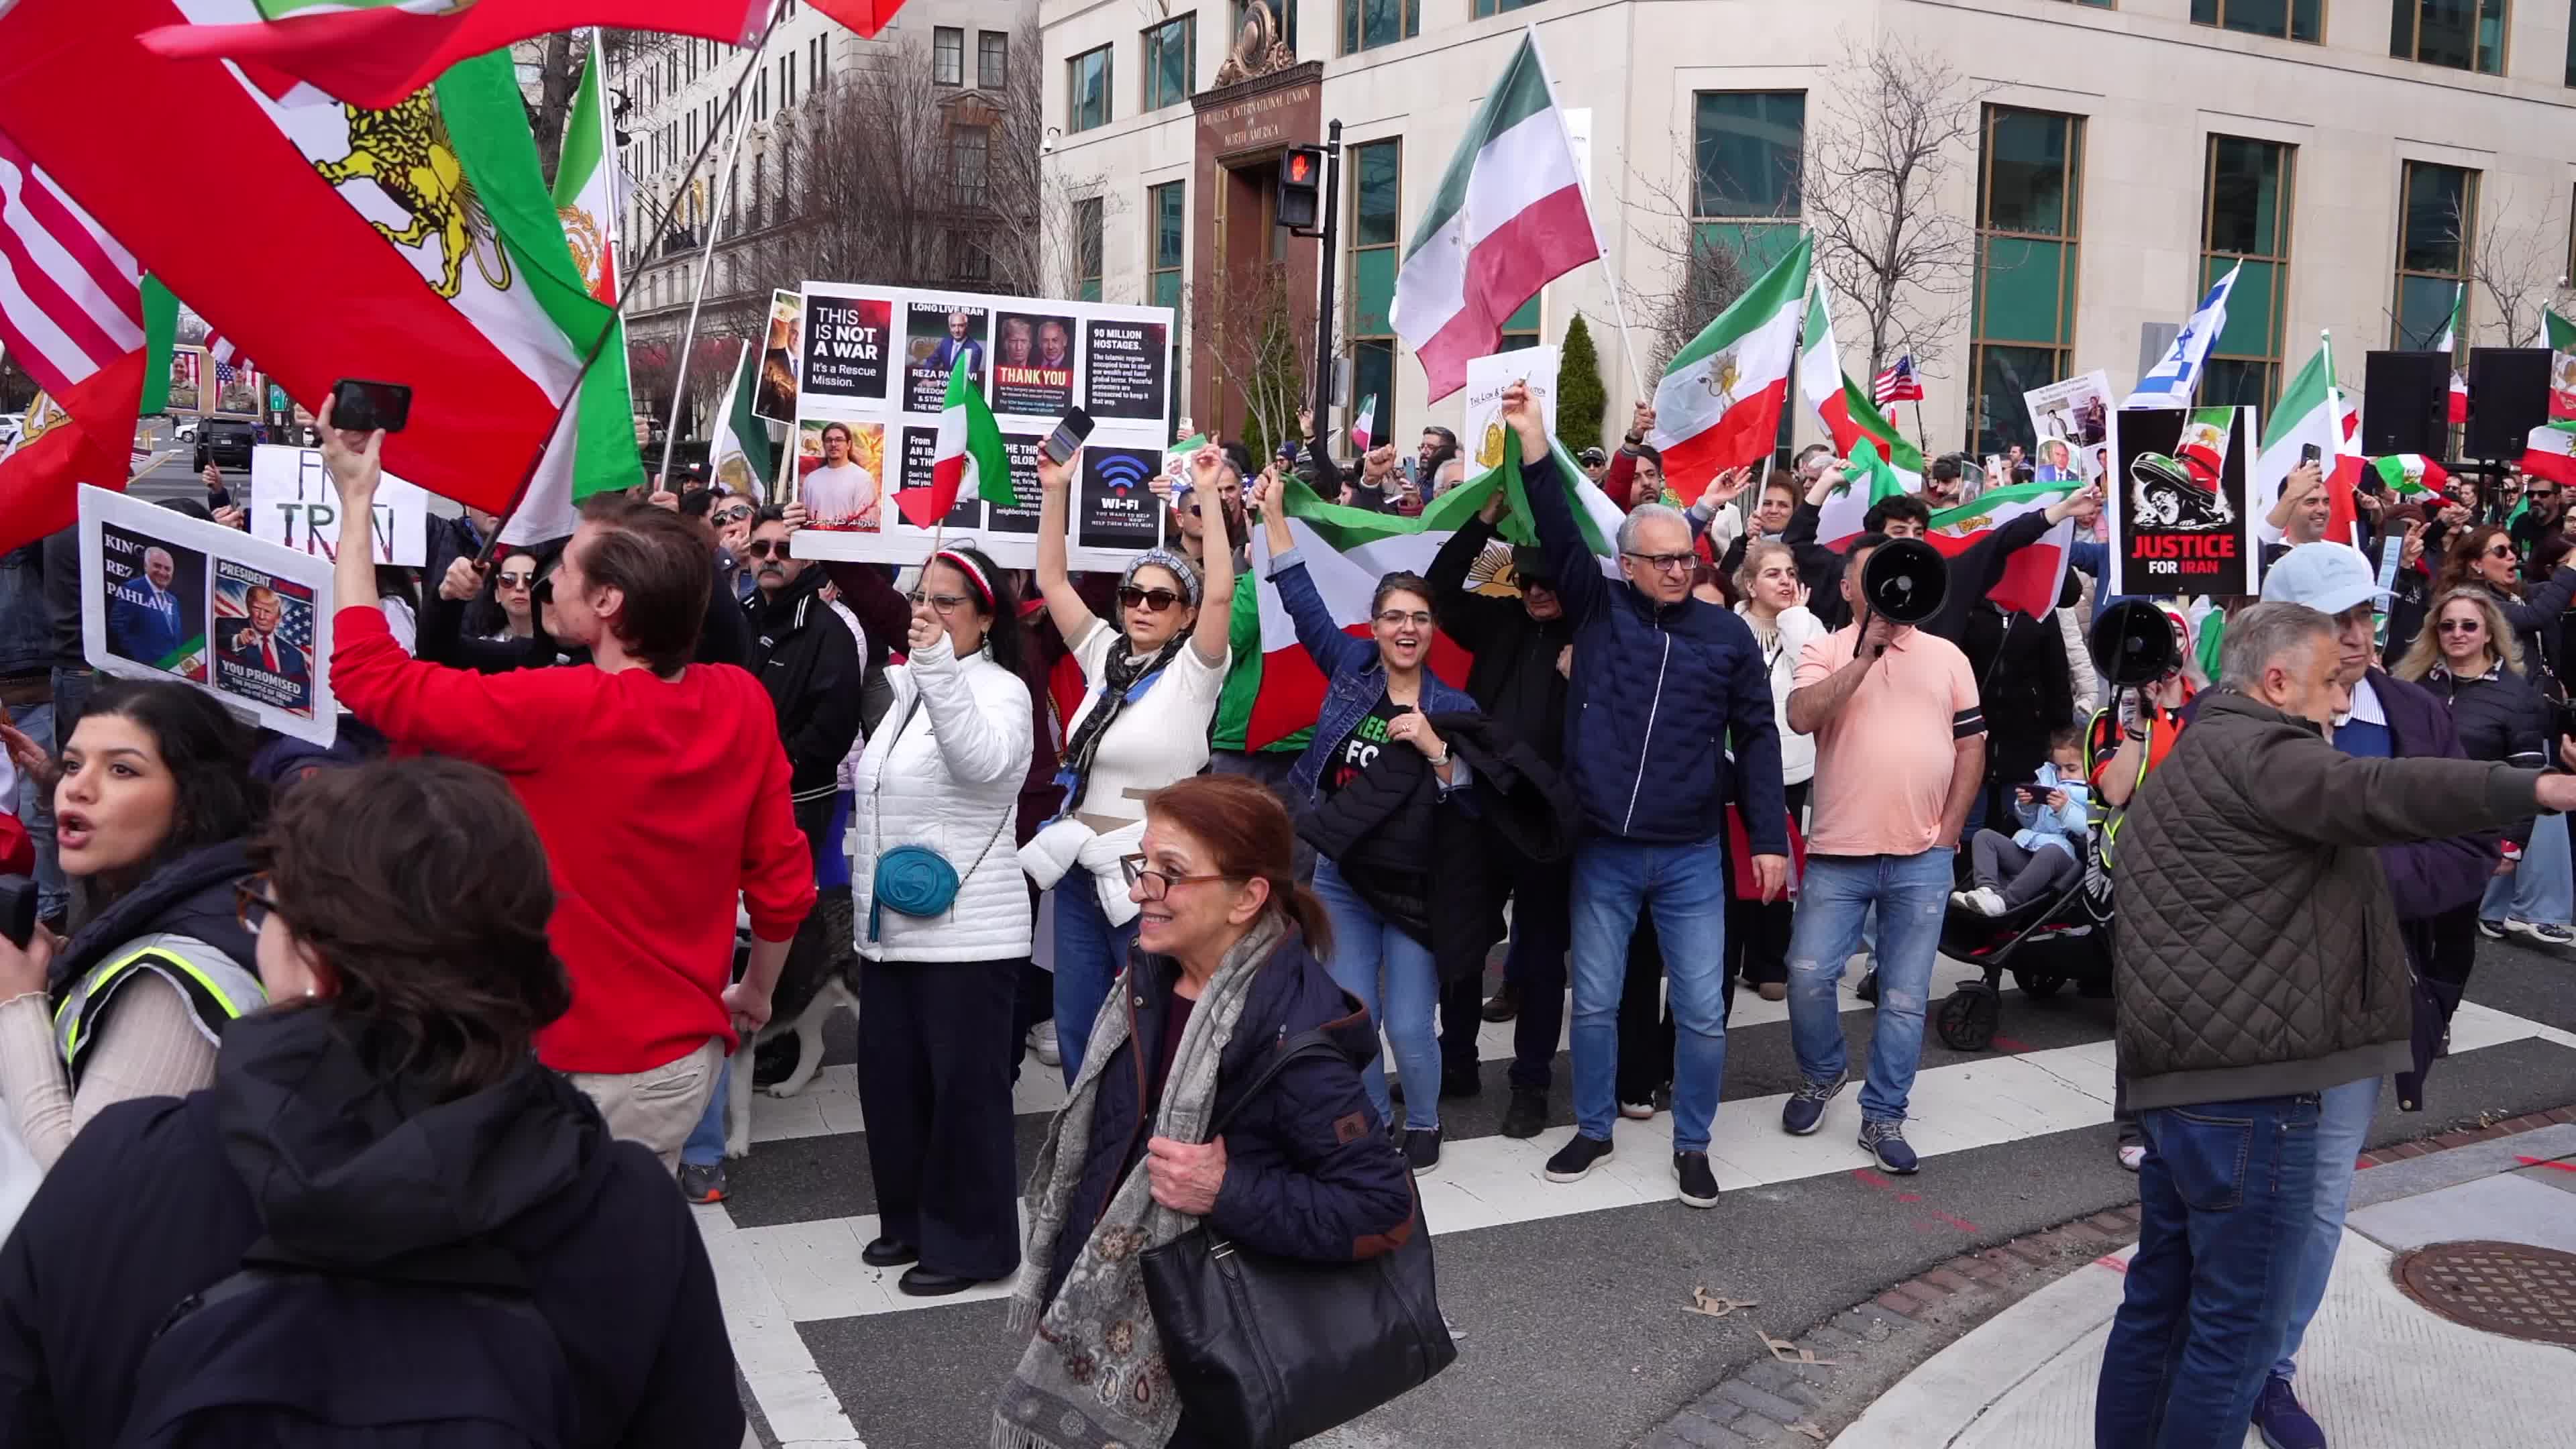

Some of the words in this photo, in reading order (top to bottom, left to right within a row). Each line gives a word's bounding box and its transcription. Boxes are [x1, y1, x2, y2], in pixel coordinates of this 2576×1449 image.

[1233, 96, 1283, 118] INTERNATIONAL
[1287, 87, 1310, 104] UNION
[1225, 130, 1246, 146] NORTH
[1250, 123, 1278, 141] AMERICA
[816, 307, 859, 325] THIS
[912, 303, 938, 313] LONG
[961, 307, 983, 316] IRAN
[816, 325, 831, 340] IS
[837, 327, 877, 343] NOT
[1094, 329, 1105, 337] 90
[1107, 329, 1142, 339] MILLION
[814, 341, 828, 357] A
[833, 342, 877, 360] WAR
[1093, 339, 1142, 350] HOSTAGES.
[813, 362, 828, 373] It's
[830, 366, 836, 374] a
[839, 364, 876, 376] Rescue
[912, 368, 936, 378] REZA
[938, 370, 977, 381] PAVI
[1000, 367, 1040, 384] THANK
[1043, 370, 1066, 385] YOU
[812, 375, 855, 387] Mission.
[910, 435, 930, 445] From
[910, 446, 922, 455] AN
[925, 447, 934, 456] IR
[909, 458, 918, 466] to
[1102, 498, 1139, 510] WI-FI
[996, 508, 1030, 517] neighboring
[276, 503, 394, 564] IRN
[2131, 535, 2235, 558] JUSTICE
[105, 558, 133, 578] REZ
[220, 561, 271, 587] PRESIDENT
[2149, 561, 2178, 574] FOR
[2181, 561, 2219, 574] IRAN
[107, 582, 172, 615] PAHLAVI
[222, 659, 244, 676] YOU
[246, 667, 301, 694] PROMISED
